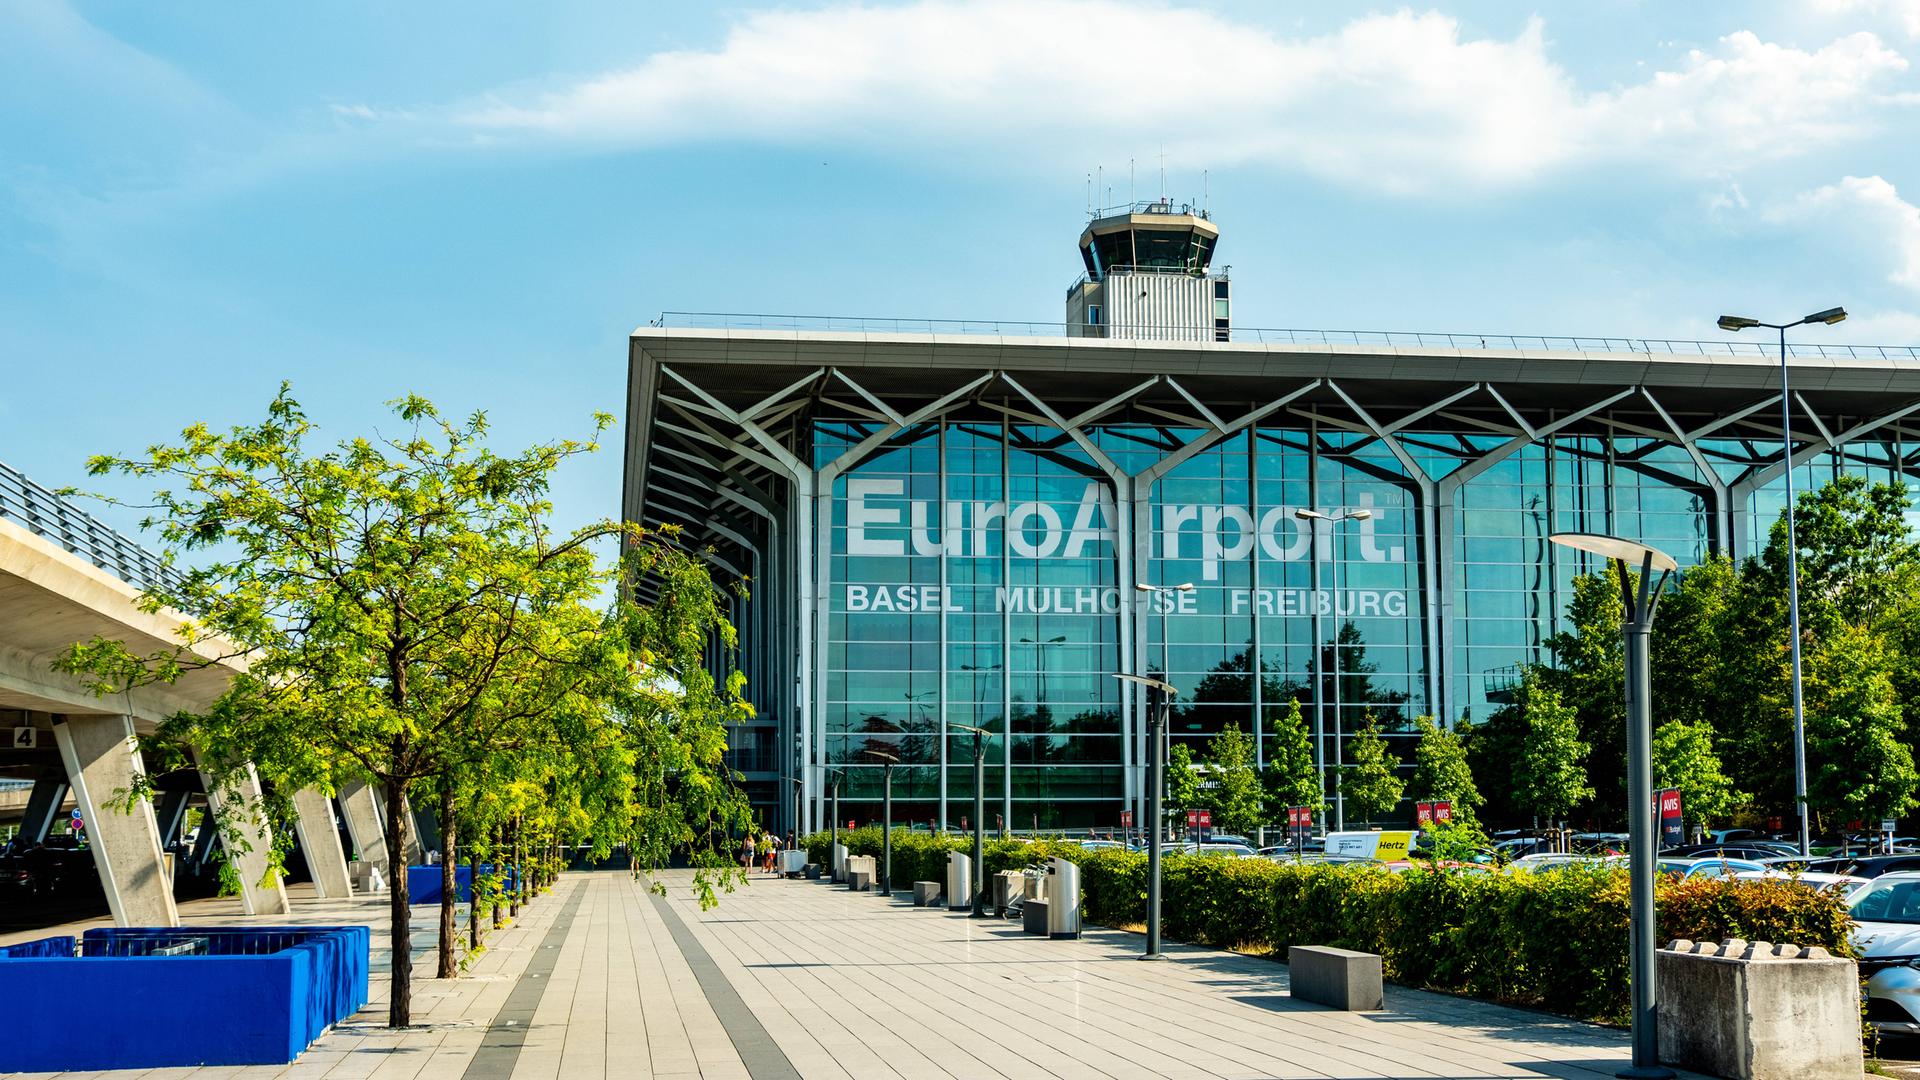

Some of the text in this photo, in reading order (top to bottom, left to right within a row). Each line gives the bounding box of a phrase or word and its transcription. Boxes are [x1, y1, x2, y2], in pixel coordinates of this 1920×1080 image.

[846, 479, 1405, 581] EuroArport. TM
[846, 585, 1407, 617] BASEL MULHOSE FREIBURG
[17, 728, 33, 747] 4
[1664, 798, 1679, 812] AVIS
[1419, 809, 1430, 819] AVIS
[1436, 808, 1450, 819] AVIS
[1379, 841, 1405, 850] Hertz
